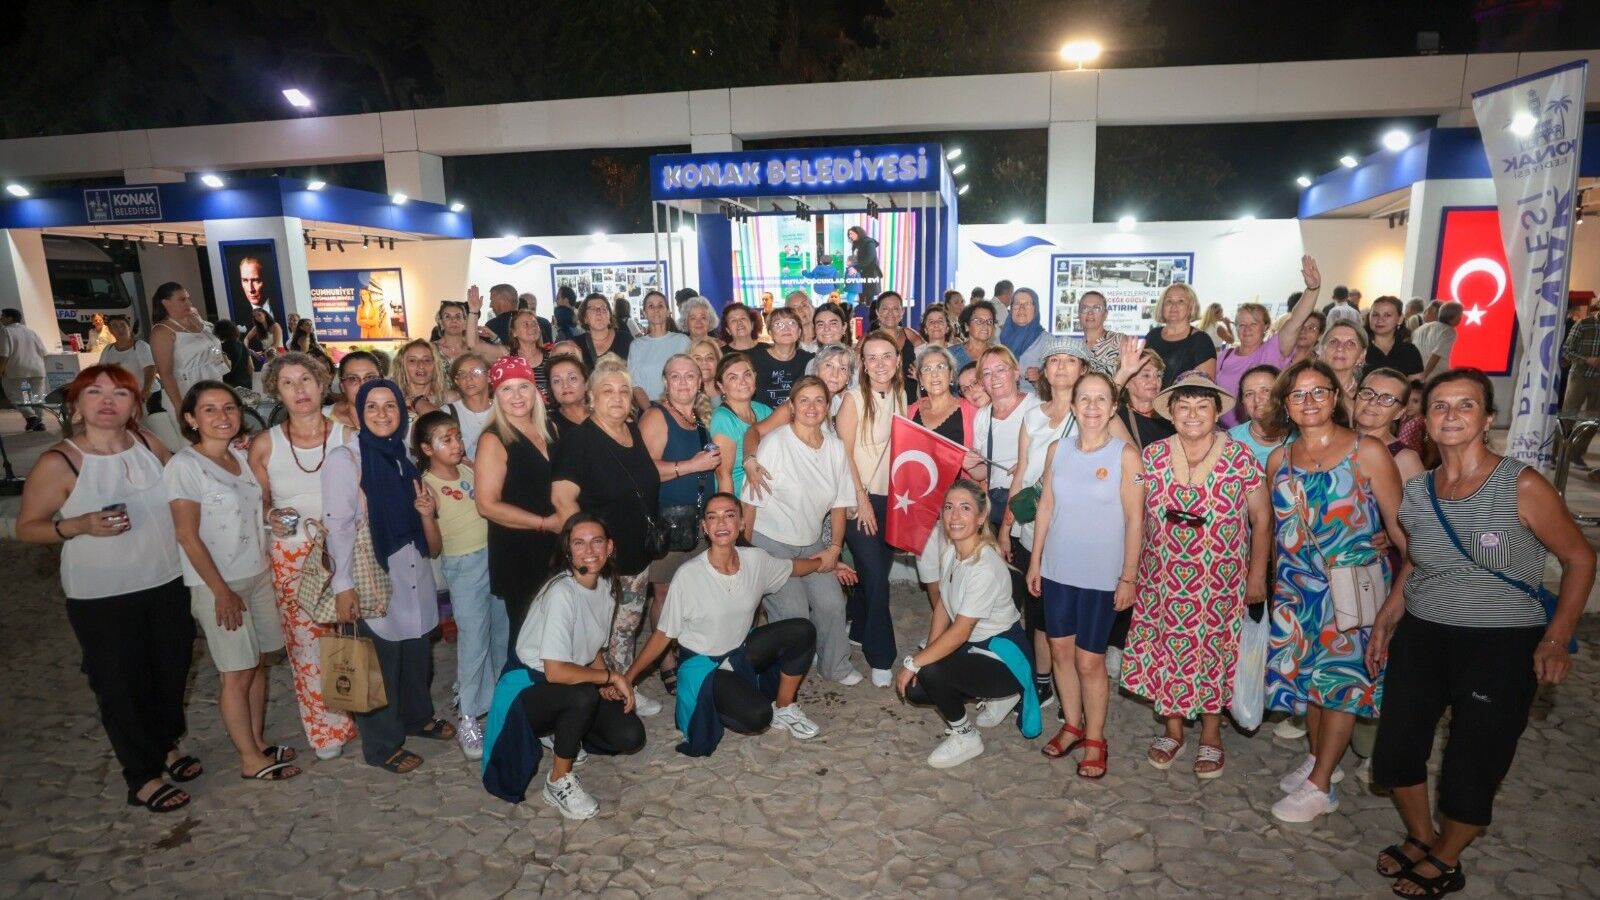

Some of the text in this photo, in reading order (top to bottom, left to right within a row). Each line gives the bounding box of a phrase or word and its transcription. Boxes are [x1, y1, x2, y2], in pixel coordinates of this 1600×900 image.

[664, 147, 927, 189] KONAK BELEDİYESİ
[113, 192, 156, 206] KONAK
[311, 286, 355, 297] CUMHURİYET
